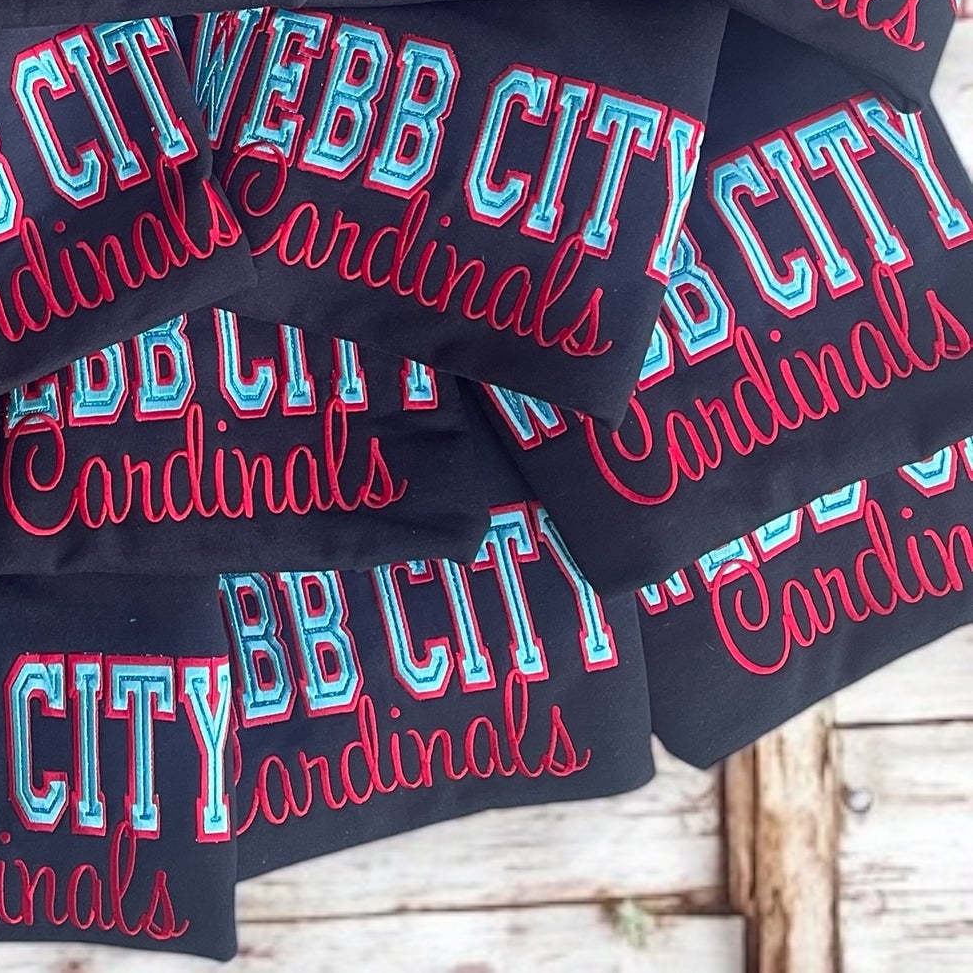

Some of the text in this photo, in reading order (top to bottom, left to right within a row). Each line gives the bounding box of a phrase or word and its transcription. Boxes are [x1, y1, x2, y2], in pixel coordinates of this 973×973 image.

[9, 15, 199, 210] CIT
[190, 6, 461, 200] WEBB
[224, 140, 614, 357] Cardinals
[707, 90, 973, 318] CITY
[2, 395, 409, 537] Cardinals
[576, 261, 973, 507] Cardinals
[218, 569, 366, 729] BB
[370, 500, 620, 701] CITY
[710, 497, 973, 676] Cardin
[3, 652, 232, 843] CITY
[232, 666, 592, 837] ardinals
